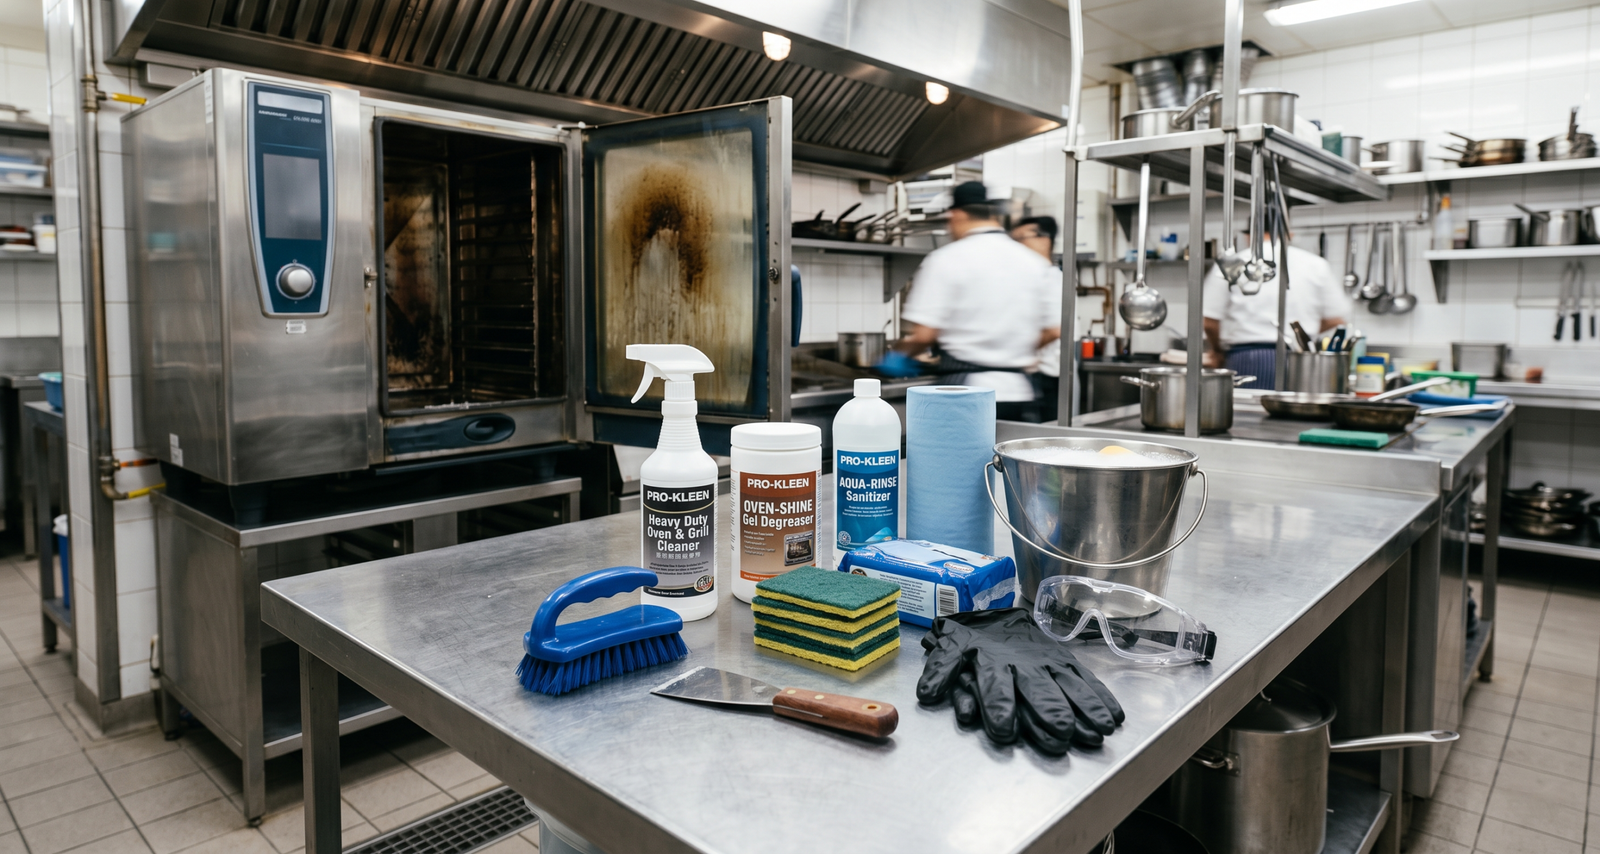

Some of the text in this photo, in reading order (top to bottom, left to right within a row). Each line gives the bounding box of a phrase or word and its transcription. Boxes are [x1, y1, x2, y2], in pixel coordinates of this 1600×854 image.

[841, 455, 895, 466] PRO-KLEEN
[747, 478, 809, 489] PRO-KLEEN
[840, 476, 897, 489] AQUA-RINSE
[647, 490, 709, 502] PRO-KLEEN
[846, 490, 891, 502] Sanitizer
[744, 499, 812, 514] OVEN-SHINE
[649, 514, 708, 529] Heavy Duty
[743, 513, 814, 530] Gel Degreaser
[647, 525, 709, 539] Oven & Grill
[658, 540, 700, 552] Cleaner
